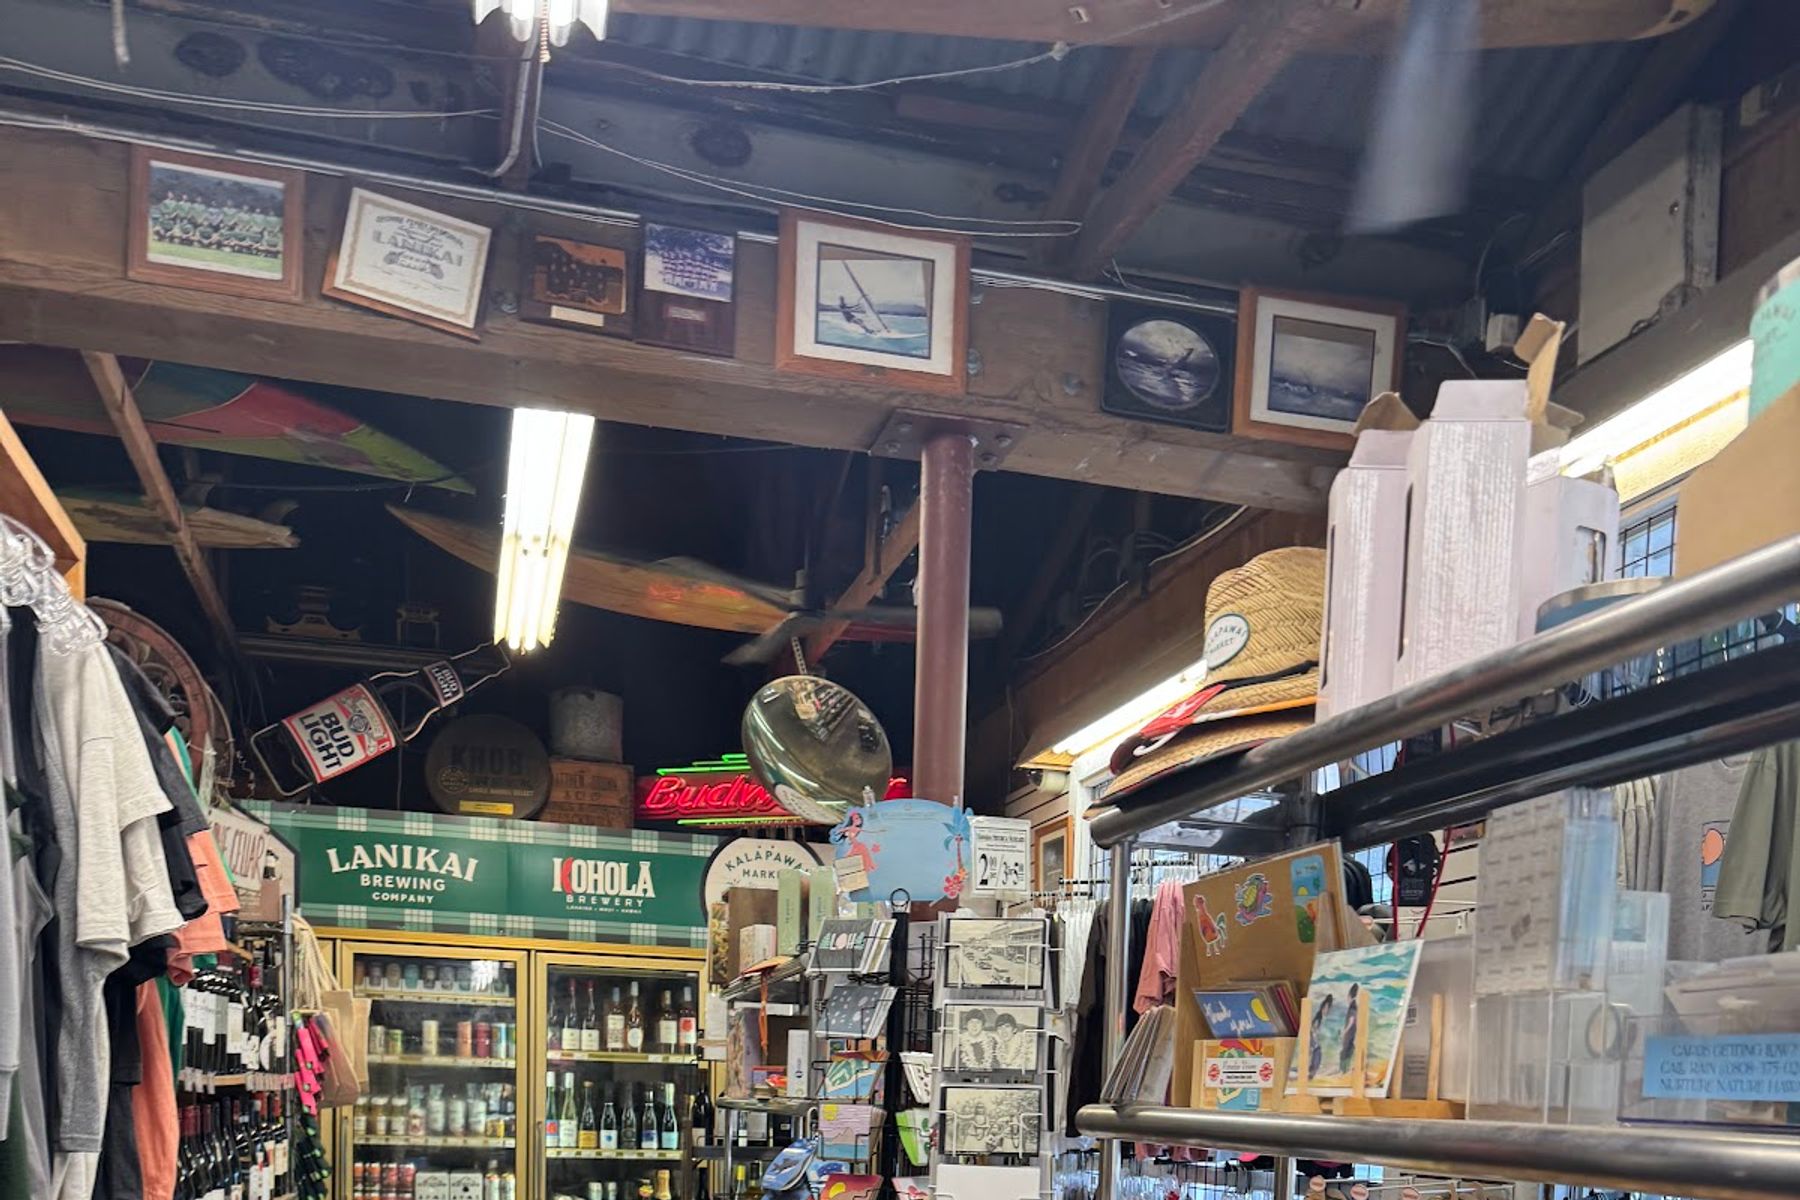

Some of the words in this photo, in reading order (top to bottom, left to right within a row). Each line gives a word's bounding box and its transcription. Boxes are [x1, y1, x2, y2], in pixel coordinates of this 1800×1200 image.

[431, 666, 453, 699] LIGHT
[442, 668, 459, 694] BUD
[299, 712, 343, 769] LIGHT
[319, 711, 355, 758] BUD
[326, 843, 479, 882] LANIKAI
[743, 868, 779, 880] MARK
[360, 873, 447, 891] BREWING
[372, 891, 434, 904] COMPANY
[566, 894, 644, 908] BREWERY
[819, 931, 865, 951] ALOHA
